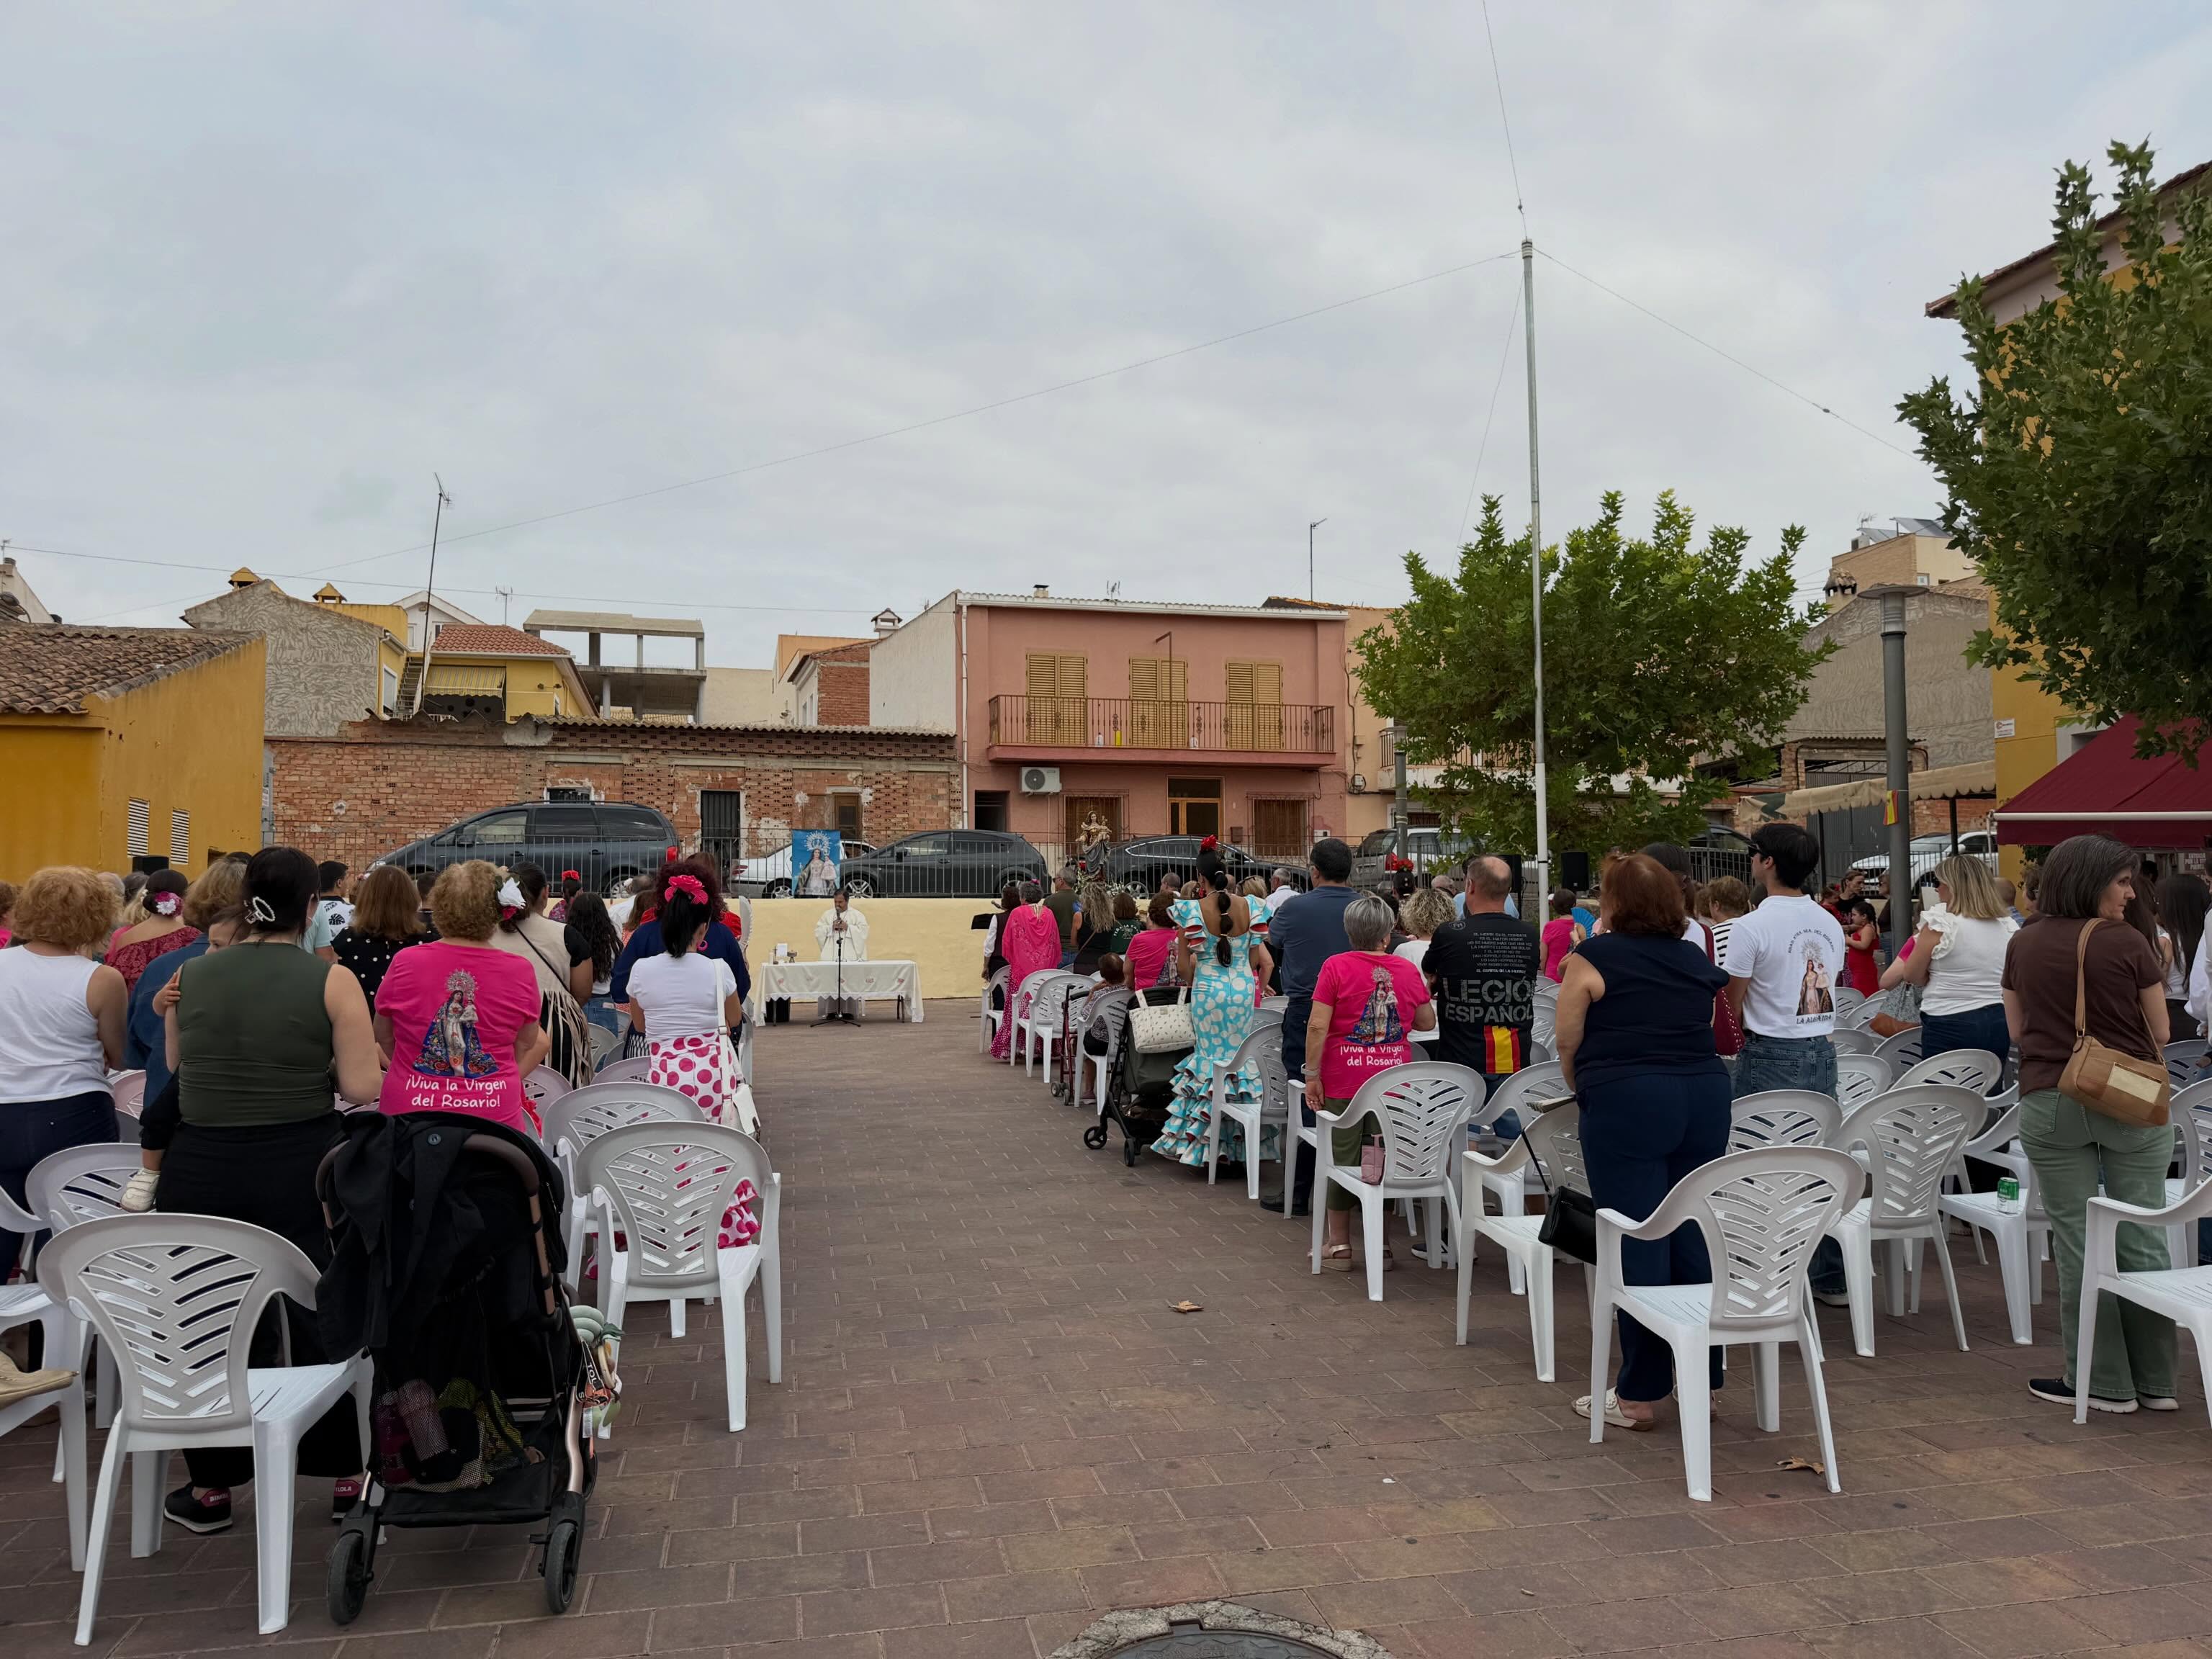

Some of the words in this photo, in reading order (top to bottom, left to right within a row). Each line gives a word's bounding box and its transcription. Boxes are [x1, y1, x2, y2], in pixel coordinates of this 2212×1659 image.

[1380, 1045, 1404, 1056] Virgen
[1346, 1055, 1362, 1066] del
[1366, 1055, 1403, 1066] Rosario!
[405, 1074, 439, 1091] ¡Viva
[446, 1079, 458, 1091] la
[464, 1079, 507, 1094] Virgen
[411, 1093, 434, 1107] del
[441, 1094, 500, 1107] Rosario!
